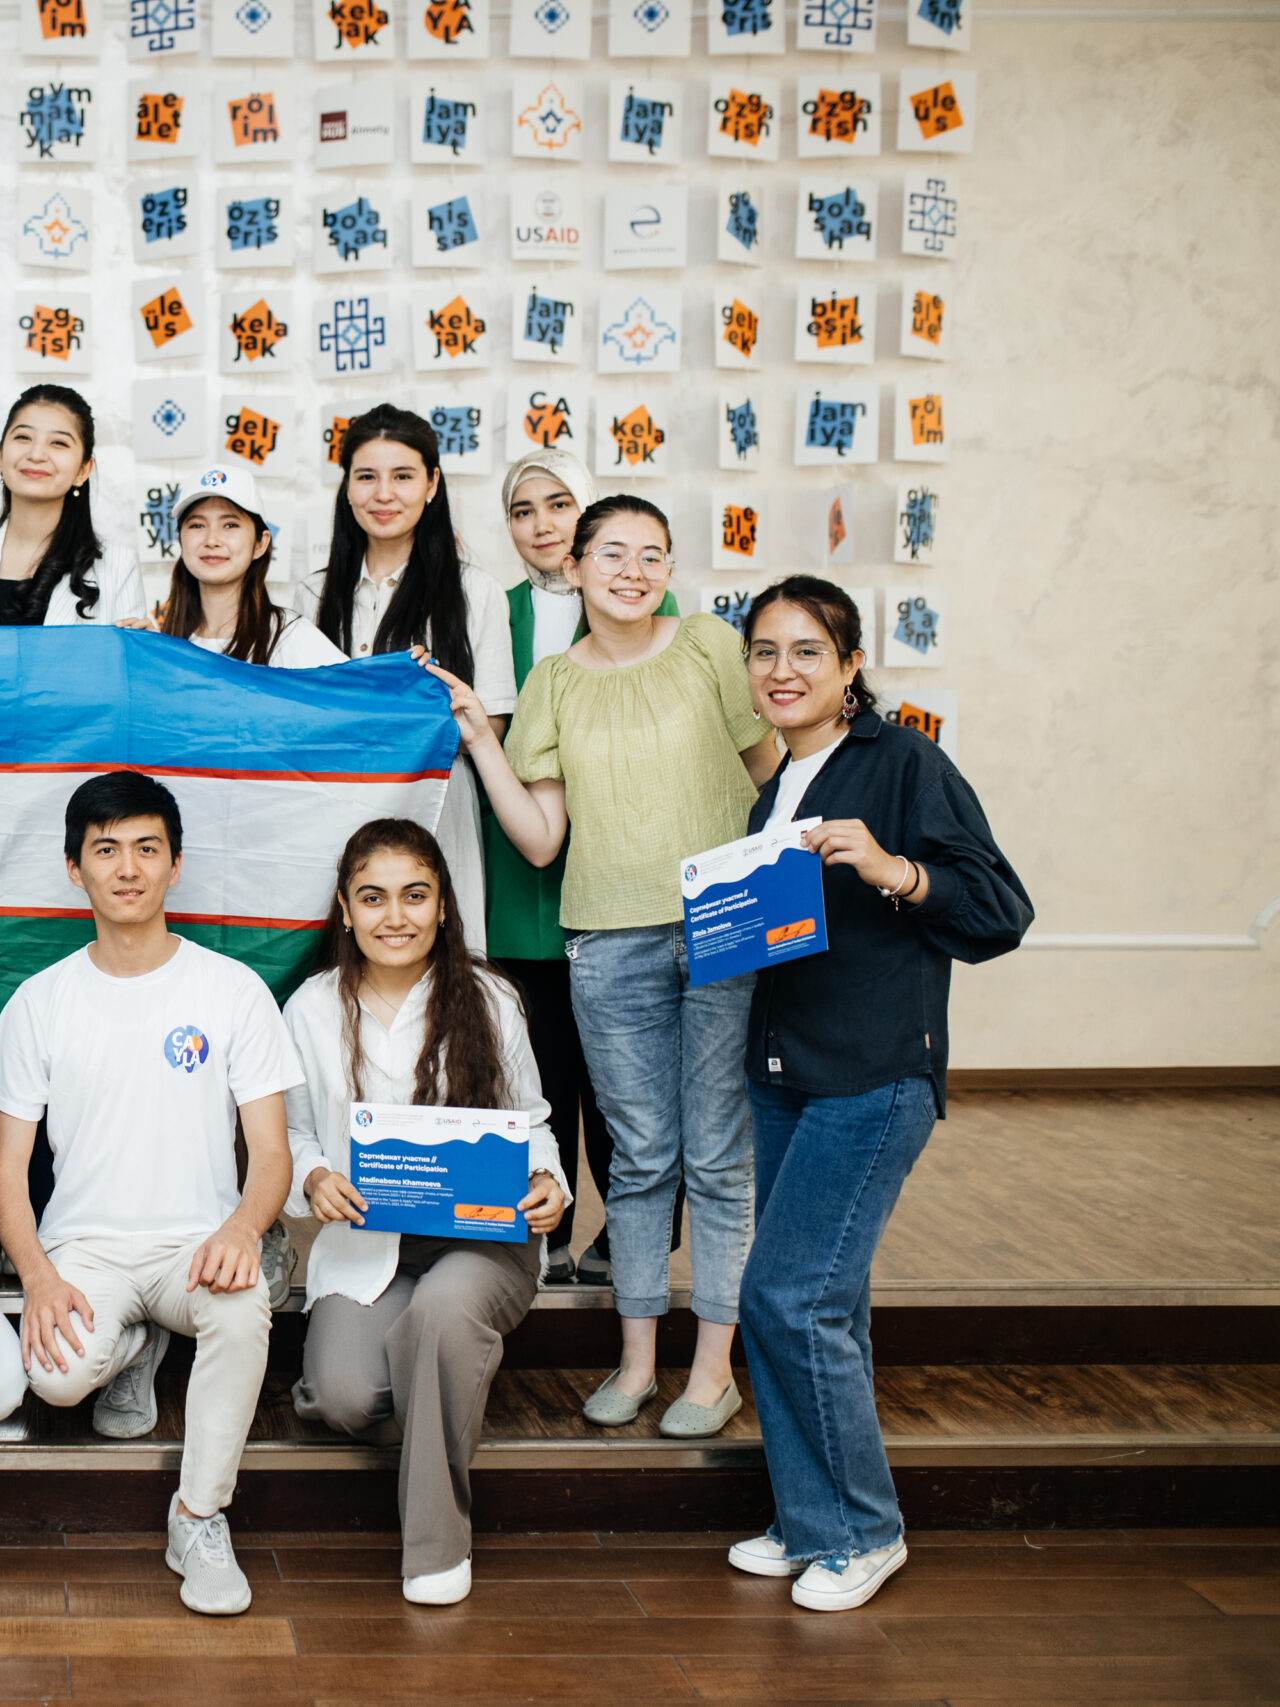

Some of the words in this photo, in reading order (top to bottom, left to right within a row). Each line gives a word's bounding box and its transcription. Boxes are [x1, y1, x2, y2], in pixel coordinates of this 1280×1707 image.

[517, 227, 580, 244] USAID
[689, 900, 721, 914] Сертификат
[722, 893, 743, 905] участия
[690, 910, 718, 923] Certificate
[724, 898, 758, 912] Participation
[359, 1152, 401, 1162] Сертификат
[402, 1155, 430, 1163] участия
[359, 1162, 394, 1170] Certificate
[404, 1164, 448, 1173] Participation
